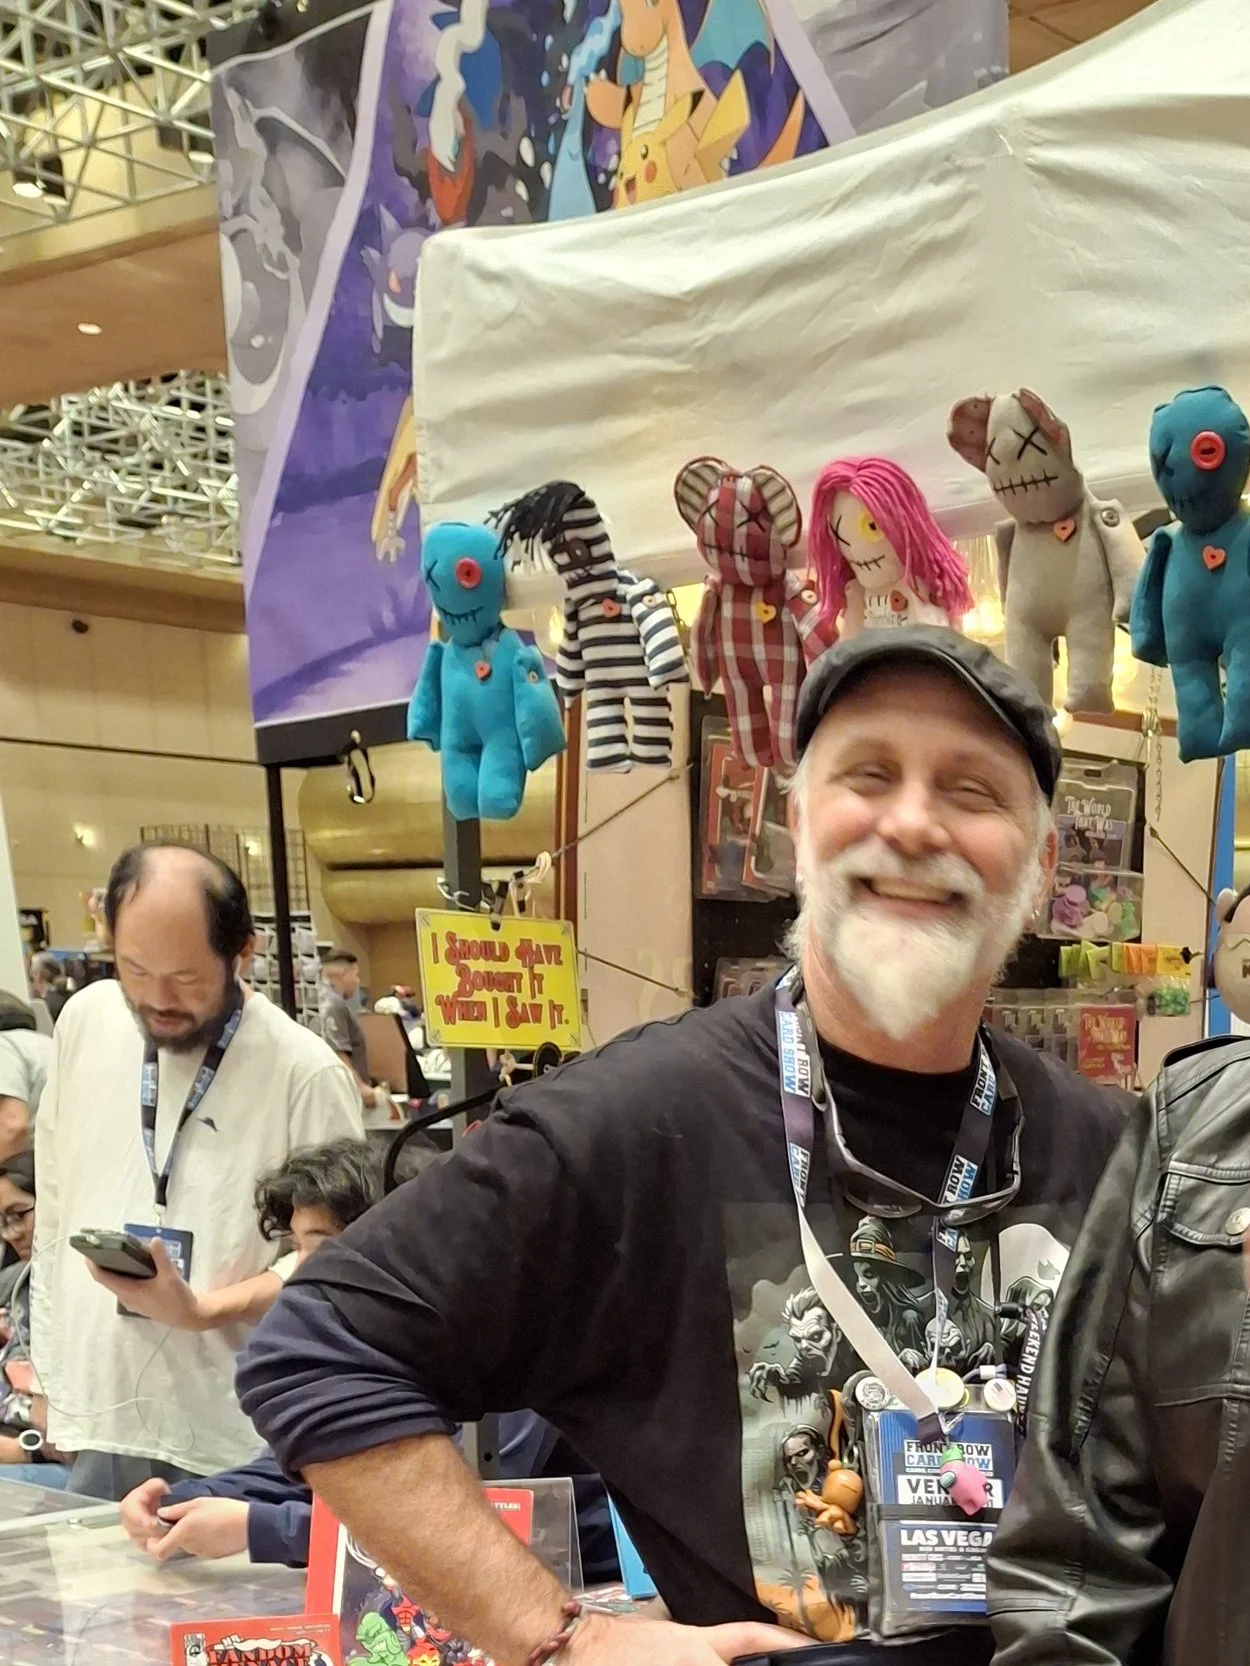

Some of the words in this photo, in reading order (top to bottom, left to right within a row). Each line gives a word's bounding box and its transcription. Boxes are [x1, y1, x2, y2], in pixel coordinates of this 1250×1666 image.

[431, 932, 439, 964] I
[445, 931, 510, 966] SHOULD
[515, 938, 563, 968] HAVE
[456, 963, 523, 998] BOUGHT
[528, 966, 544, 999] IT
[435, 991, 487, 1025] WHEN
[492, 996, 500, 1028] I
[505, 995, 543, 1029] SAW
[549, 999, 569, 1029] IT.
[784, 1049, 797, 1093] SHOW
[798, 1057, 810, 1096] ROW
[971, 1063, 989, 1107] FRONT
[948, 1157, 965, 1196] ROW
[957, 1162, 978, 1201] HOW
[901, 1530, 939, 1545] LAS
[941, 1530, 993, 1547] VEGA
[207, 1643, 313, 1664] FANDOM
